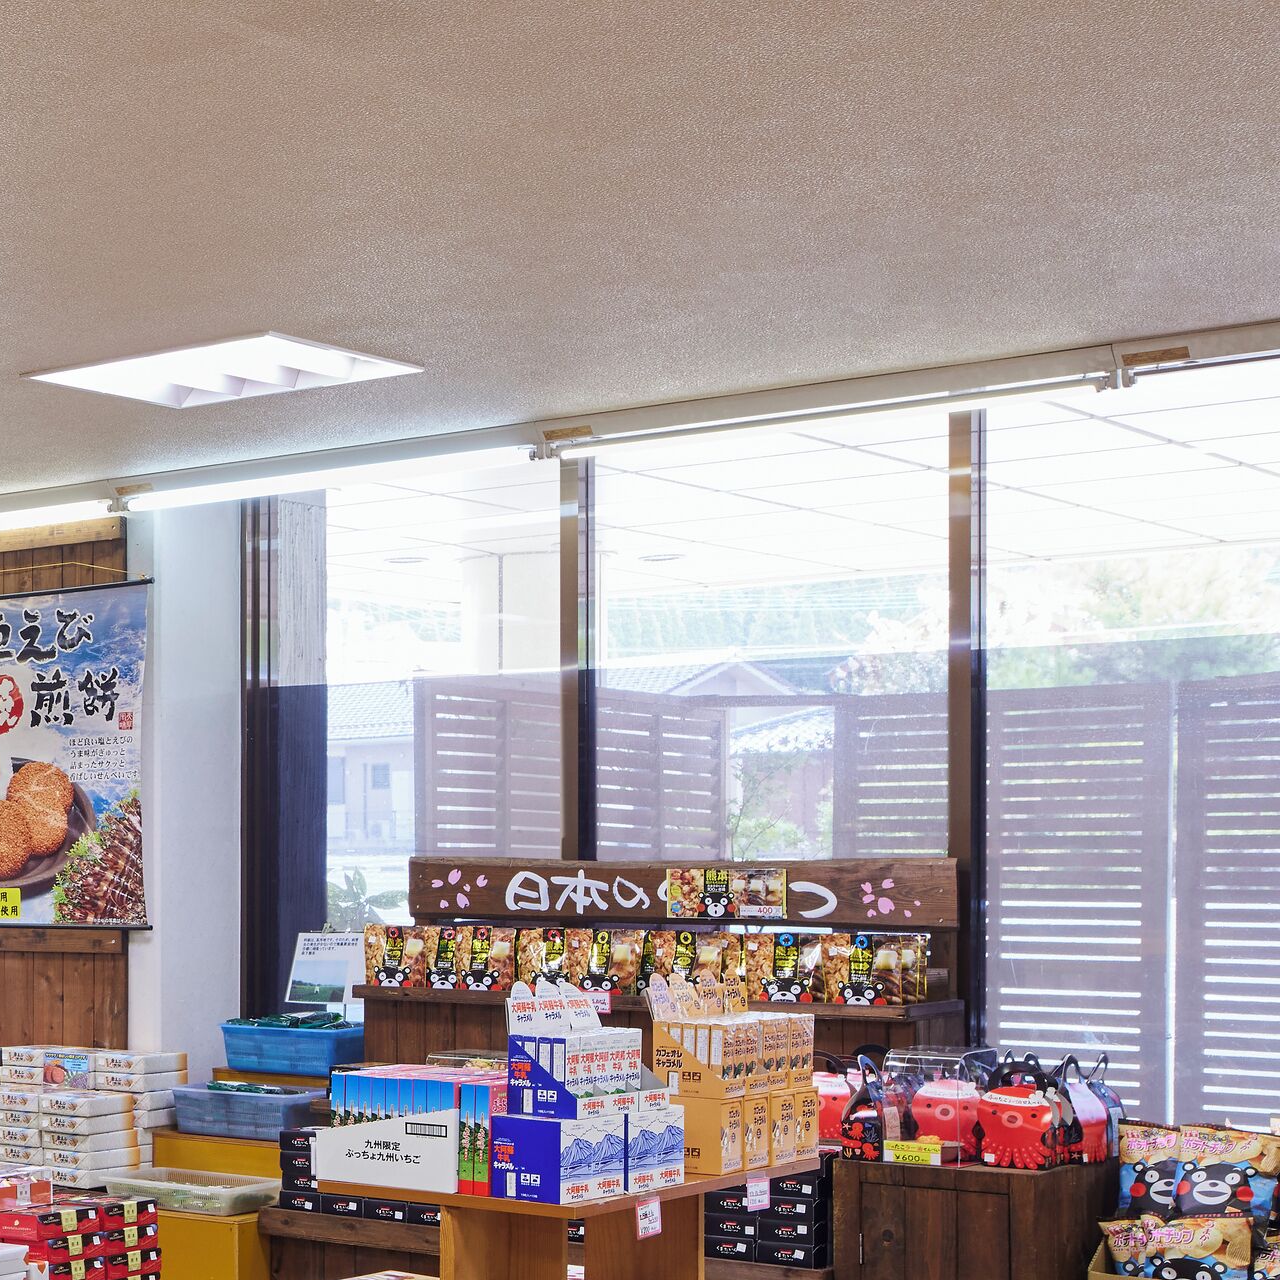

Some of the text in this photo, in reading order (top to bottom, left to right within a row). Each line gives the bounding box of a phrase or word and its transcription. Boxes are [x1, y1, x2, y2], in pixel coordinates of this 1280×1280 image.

[30, 668, 120, 728] 煎餅
[69, 736, 133, 747] ほど良い塩とえびの
[70, 759, 126, 770] 詰まったサクッと
[655, 1048, 682, 1058] カフェオレ
[656, 1058, 682, 1069] キャラメル
[365, 1140, 400, 1151] 九州限定
